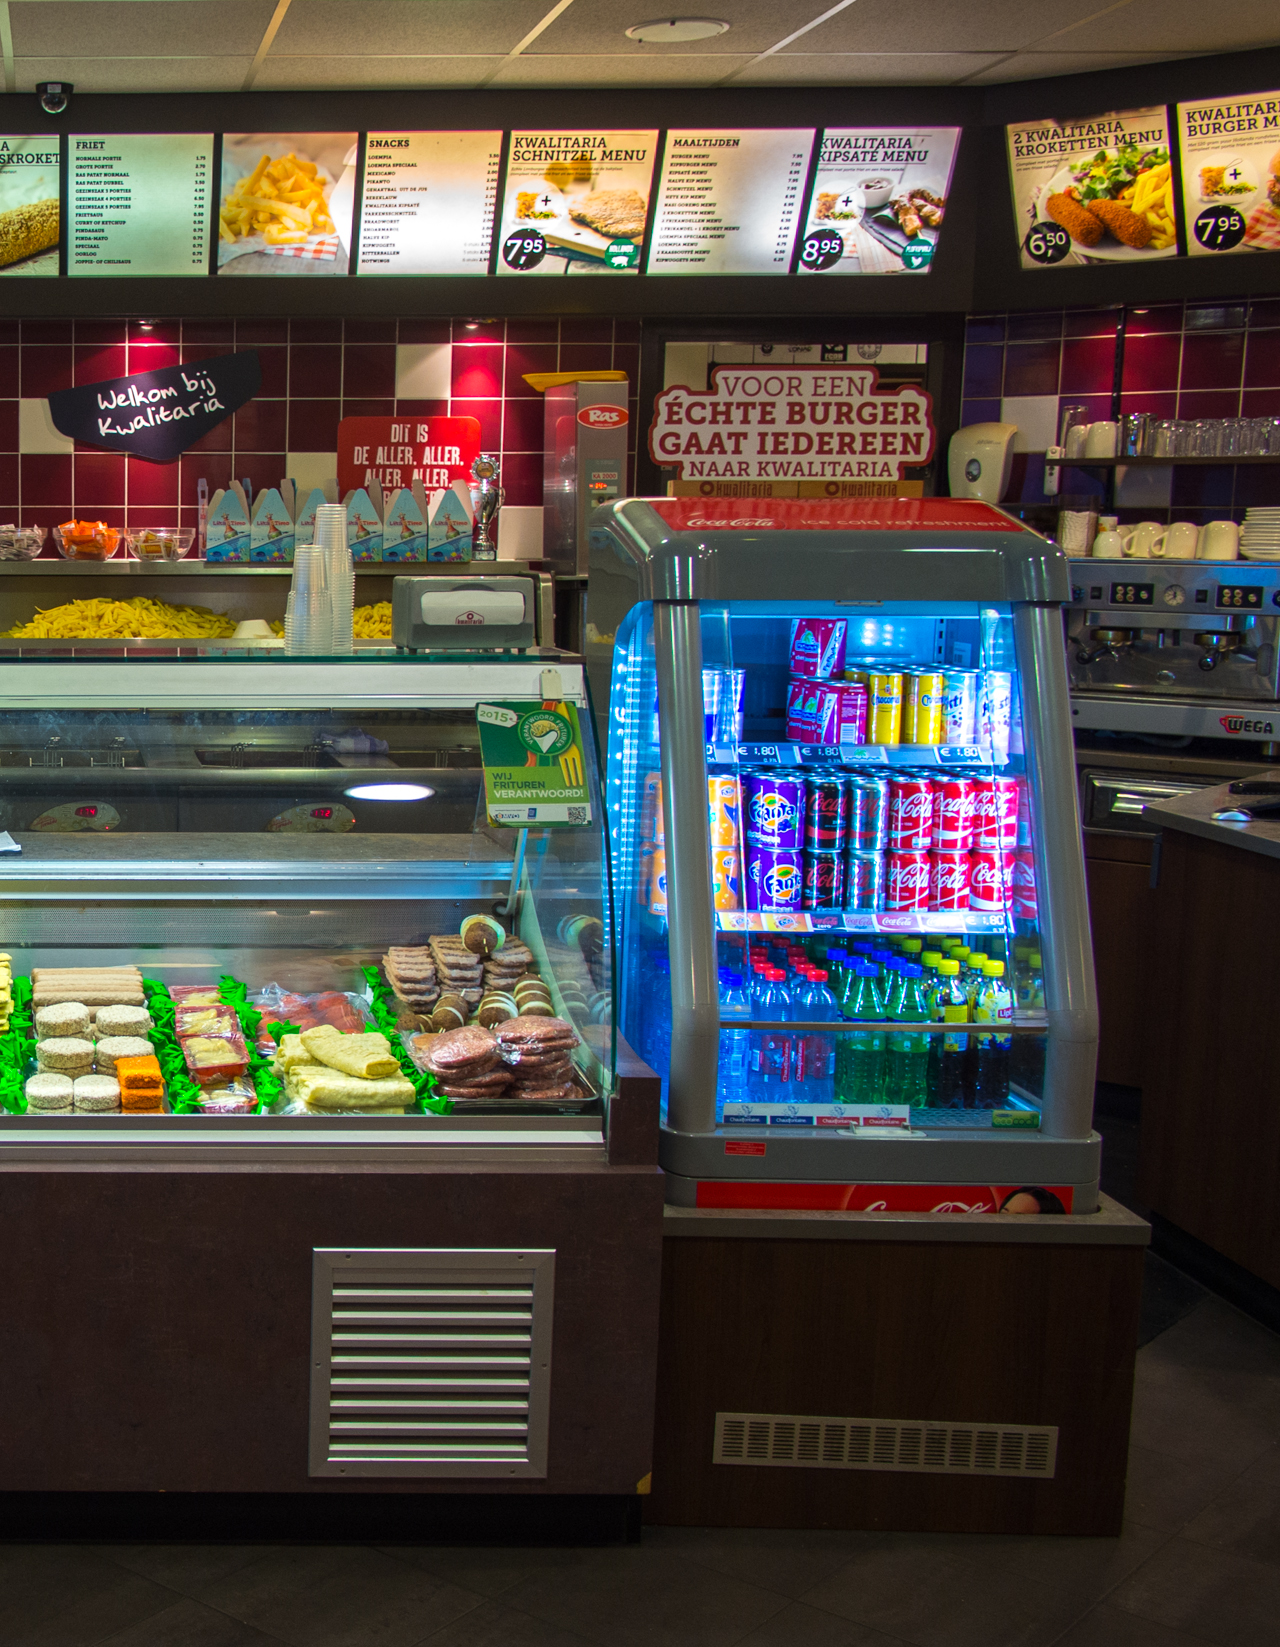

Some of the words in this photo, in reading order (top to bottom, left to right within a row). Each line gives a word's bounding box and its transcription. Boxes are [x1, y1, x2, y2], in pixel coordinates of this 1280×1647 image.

[1014, 134, 1022, 143] 2
[1026, 122, 1124, 142] KWALITARIA
[1187, 118, 1258, 137] BURGER
[514, 137, 607, 148] KWALITARIA
[821, 138, 912, 149] KWALITARIA
[1015, 136, 1108, 157] KROKETTEN
[1114, 130, 1163, 146] MENU
[512, 150, 597, 161] SCHNITZEL
[600, 150, 647, 161] MENU
[881, 150, 928, 162] MENU
[1197, 217, 1240, 243] 7,95
[506, 238, 543, 264] 7,95
[802, 240, 840, 264] 8,95
[1029, 233, 1065, 257] 6,50
[98, 385, 178, 410] Welkom
[181, 371, 216, 396] bij
[722, 376, 802, 397] VOOR
[811, 376, 867, 397] EEN
[98, 396, 225, 436] Kwalitaria
[588, 410, 619, 422] Ras
[664, 396, 776, 425] ÉCHTE
[786, 402, 921, 425] BURGER
[390, 424, 411, 442] DIT
[416, 424, 428, 442] IS
[658, 432, 748, 455] GAAT
[756, 432, 924, 455] IEDEREEN
[354, 446, 370, 465] DE
[376, 446, 417, 465] ALLER.
[423, 446, 464, 465] ALLER.
[688, 461, 750, 477] NAAR
[756, 461, 893, 477] KWALITARIA
[716, 482, 773, 497] kwalitaria
[841, 482, 897, 497] kwalitaria
[480, 710, 509, 722] 2015
[523, 714, 555, 745] VERANTWOORD
[555, 720, 567, 748] FRITUREN
[1228, 720, 1274, 734] WEGA
[492, 772, 512, 780] WIJ
[494, 789, 584, 798] VERANTWOORD!
